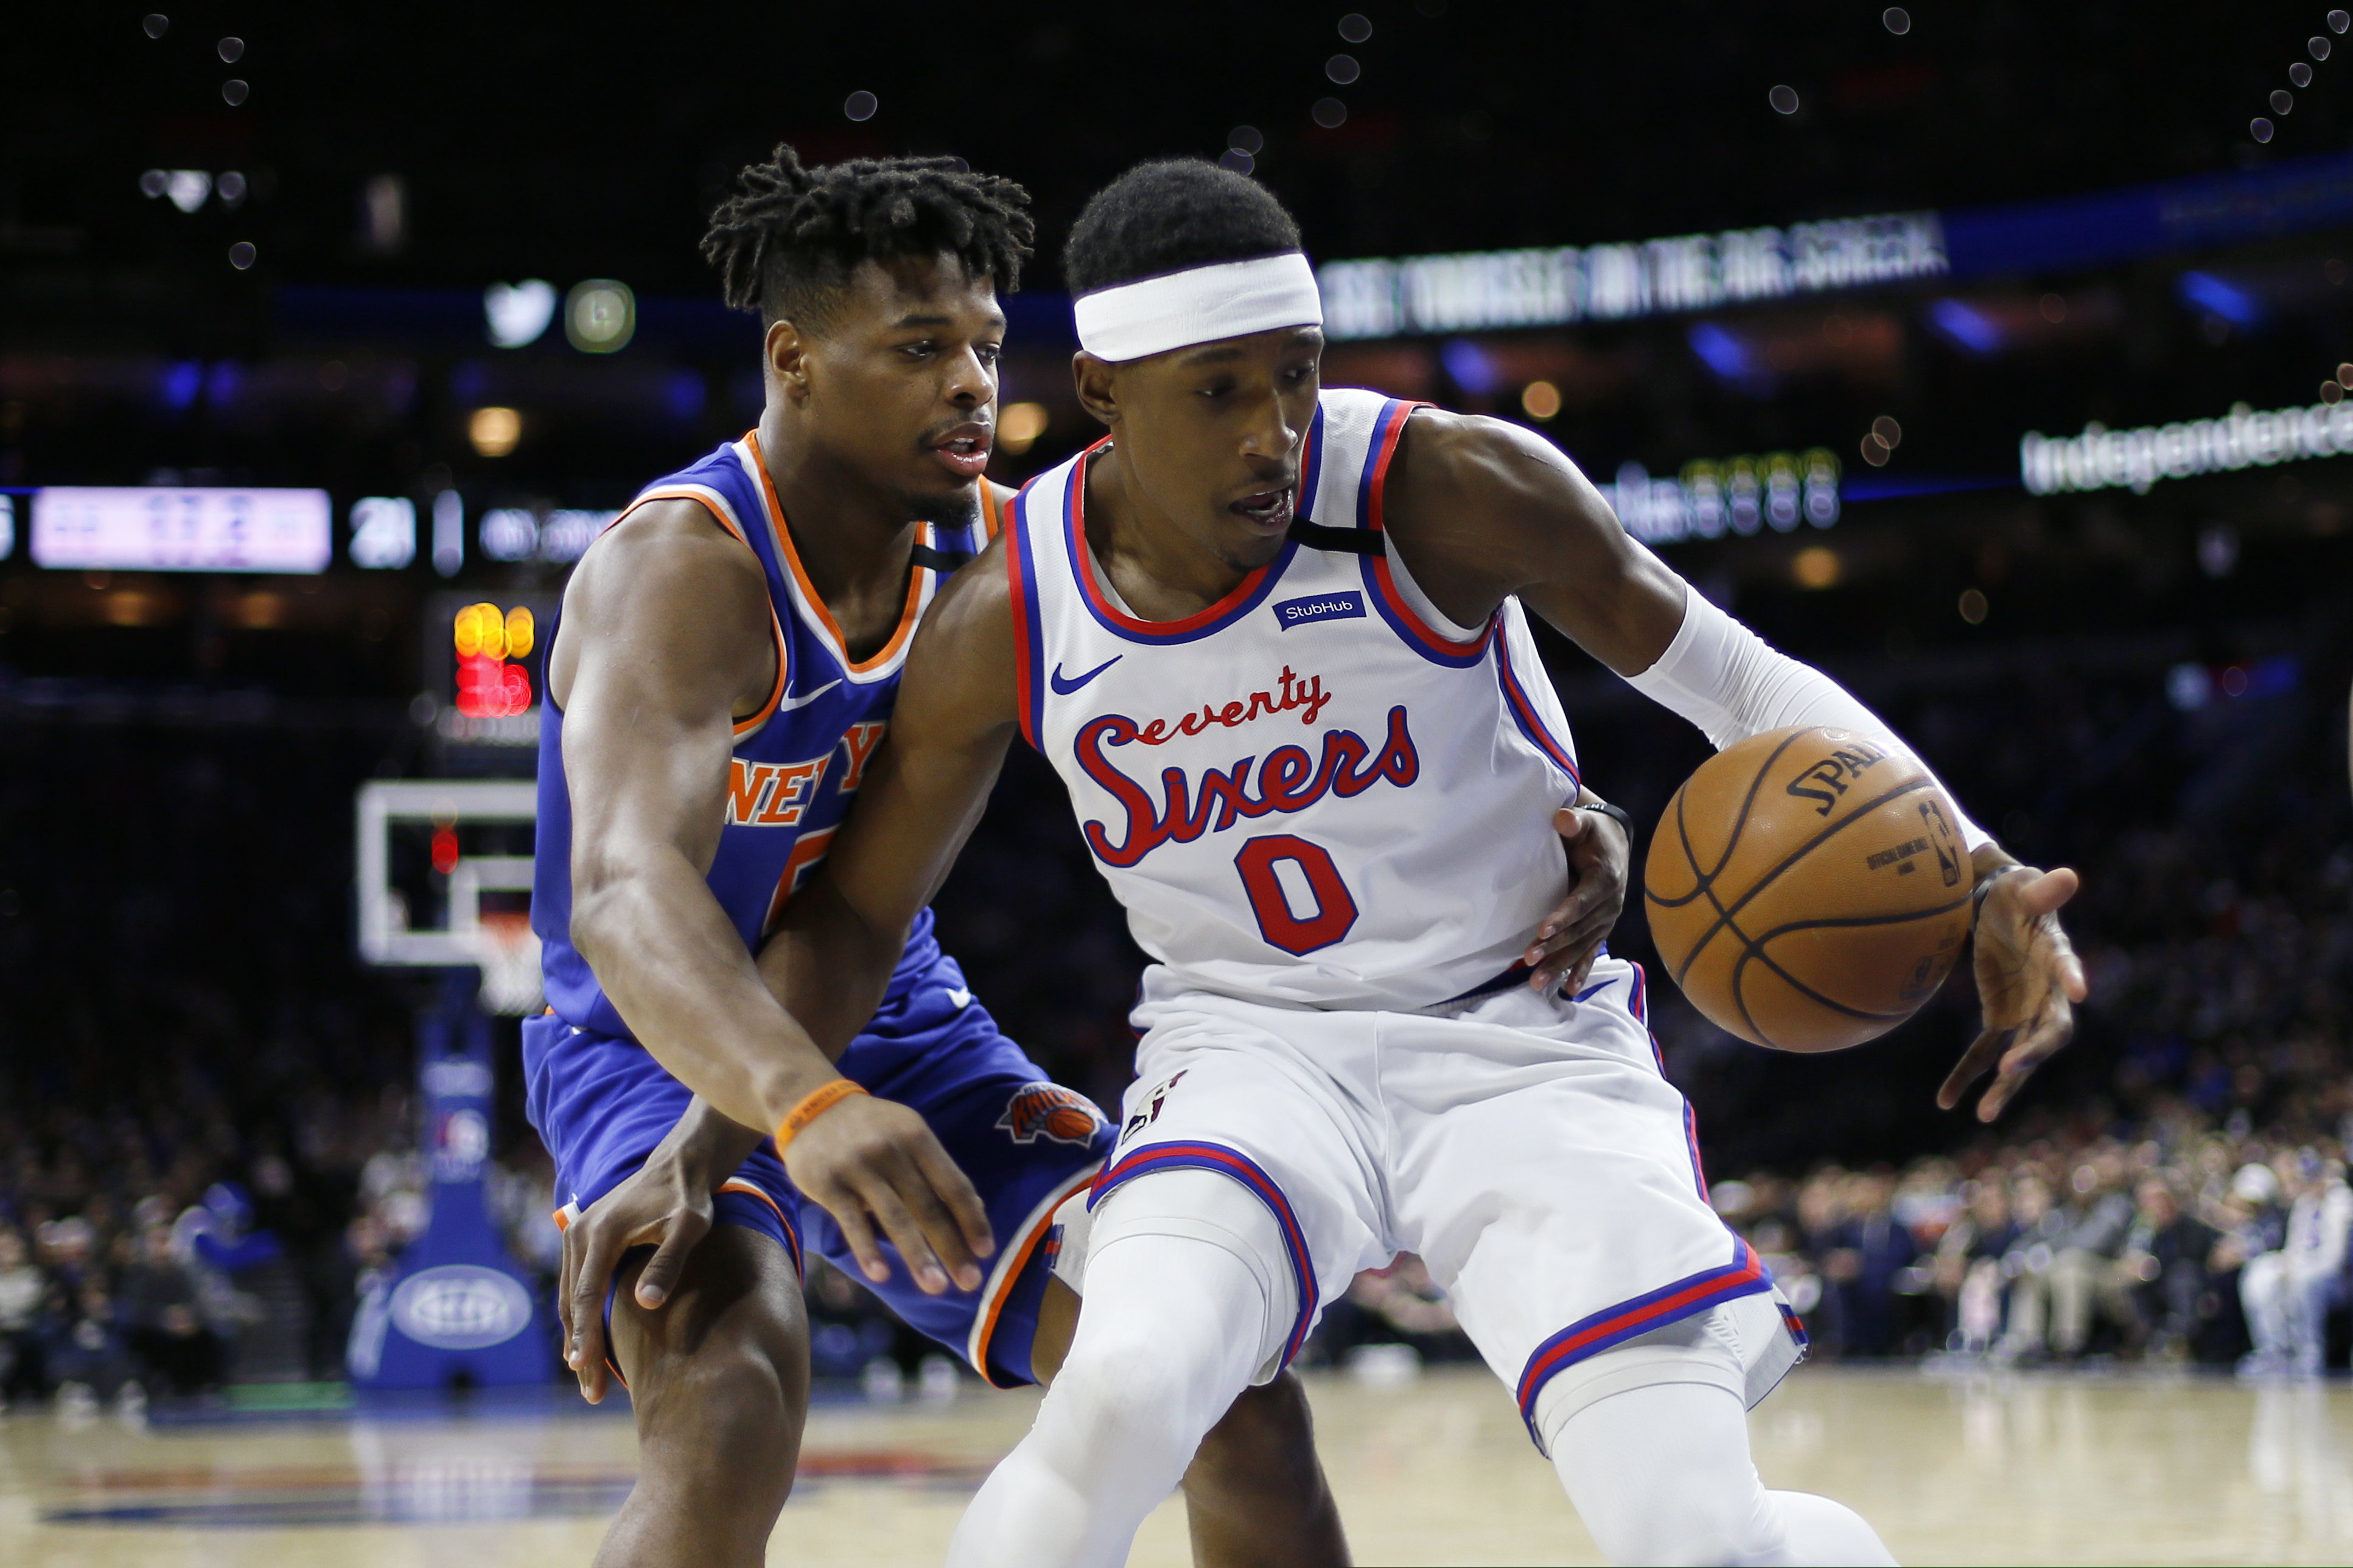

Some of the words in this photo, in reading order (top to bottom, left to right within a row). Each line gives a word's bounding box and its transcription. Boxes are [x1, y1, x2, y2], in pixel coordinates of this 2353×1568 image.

[1285, 601, 1353, 619] StubHub
[724, 750, 833, 827] NE
[1074, 705, 1419, 868] Sixers
[1786, 740, 1887, 817] SPAL
[1233, 834, 1359, 957] 0
